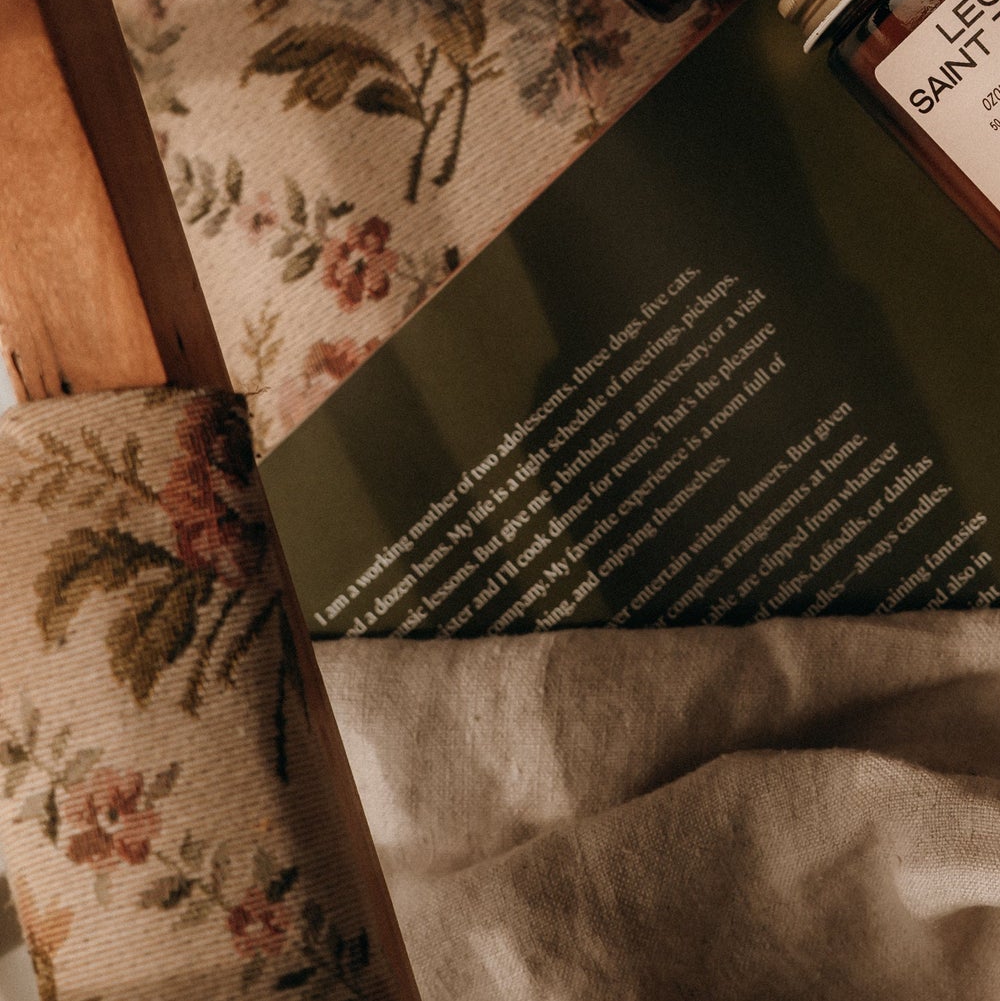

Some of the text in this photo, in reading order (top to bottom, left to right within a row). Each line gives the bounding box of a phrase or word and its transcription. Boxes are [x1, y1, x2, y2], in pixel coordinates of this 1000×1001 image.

[909, 28, 991, 114] SAINT
[324, 593, 351, 621] am
[354, 534, 415, 589] working
[408, 488, 459, 540] mother
[456, 470, 475, 495] of
[469, 452, 500, 482] two
[571, 347, 612, 385] three
[639, 292, 670, 320] five
[373, 573, 419, 617] dozen
[410, 544, 454, 578] hens.
[445, 522, 474, 545] My
[466, 498, 497, 525] life
[513, 447, 551, 483] tight
[547, 394, 608, 452] schedule
[604, 374, 623, 398] of
[420, 562, 481, 611] lessons.
[472, 534, 504, 564] But
[499, 509, 531, 544] give
[526, 489, 553, 515] me
[616, 409, 638, 432] an
[708, 323, 727, 344] or
[732, 287, 767, 319] visit
[471, 577, 502, 611] and
[515, 532, 553, 569] cook
[547, 491, 594, 539] dinner
[589, 472, 614, 498] for
[610, 435, 663, 478] twenty.
[693, 374, 721, 400] the
[717, 322, 777, 382] pleasure
[542, 350, 787, 584] My favorite experience room full of
[629, 550, 693, 611] entertain
[687, 503, 743, 555] without
[785, 434, 817, 463] But
[813, 401, 854, 442] given
[736, 441, 900, 599] are clipped from whatever
[867, 497, 886, 519] or
[883, 454, 934, 504] dahlias
[571, 456, 732, 603] and enjoying themselves.
[667, 567, 725, 619] complex
[720, 484, 812, 570] arrangements
[923, 511, 988, 571] fantasies
[945, 550, 994, 596] also in
